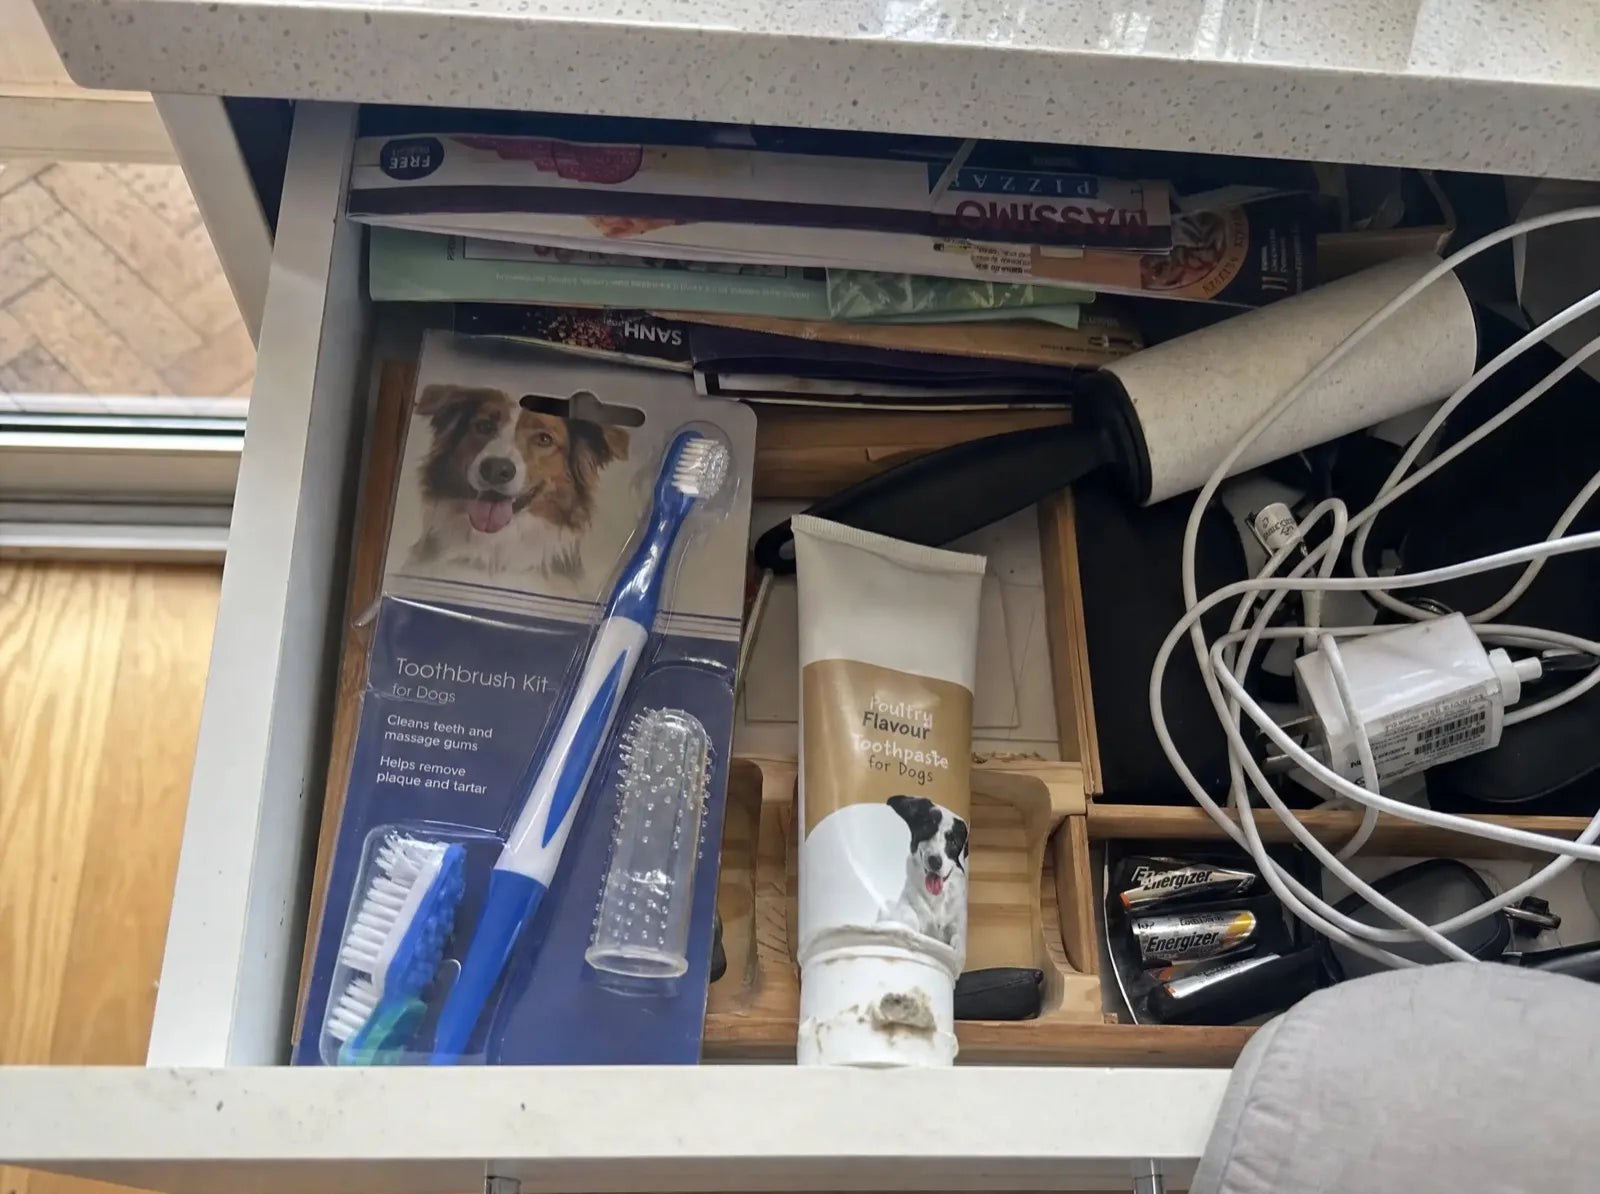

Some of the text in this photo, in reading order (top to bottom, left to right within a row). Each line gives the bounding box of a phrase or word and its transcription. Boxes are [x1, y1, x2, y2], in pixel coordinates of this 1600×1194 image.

[389, 155, 431, 170] FREE
[955, 200, 1149, 237] MASSIMO
[396, 657, 549, 694] Toothbrush Kit
[392, 683, 456, 705] for Dogs
[870, 694, 934, 728] Poultry
[387, 714, 493, 739] Cleans teeth and
[862, 711, 931, 740] Flavour
[384, 730, 478, 752] massage gums
[852, 734, 949, 769] Toothpaste
[380, 756, 467, 777] Helps remove
[868, 755, 934, 786] for Dogs
[376, 772, 488, 795] plaque and tartar
[1131, 866, 1213, 891] Energizer
[1145, 930, 1220, 953] Energizer
